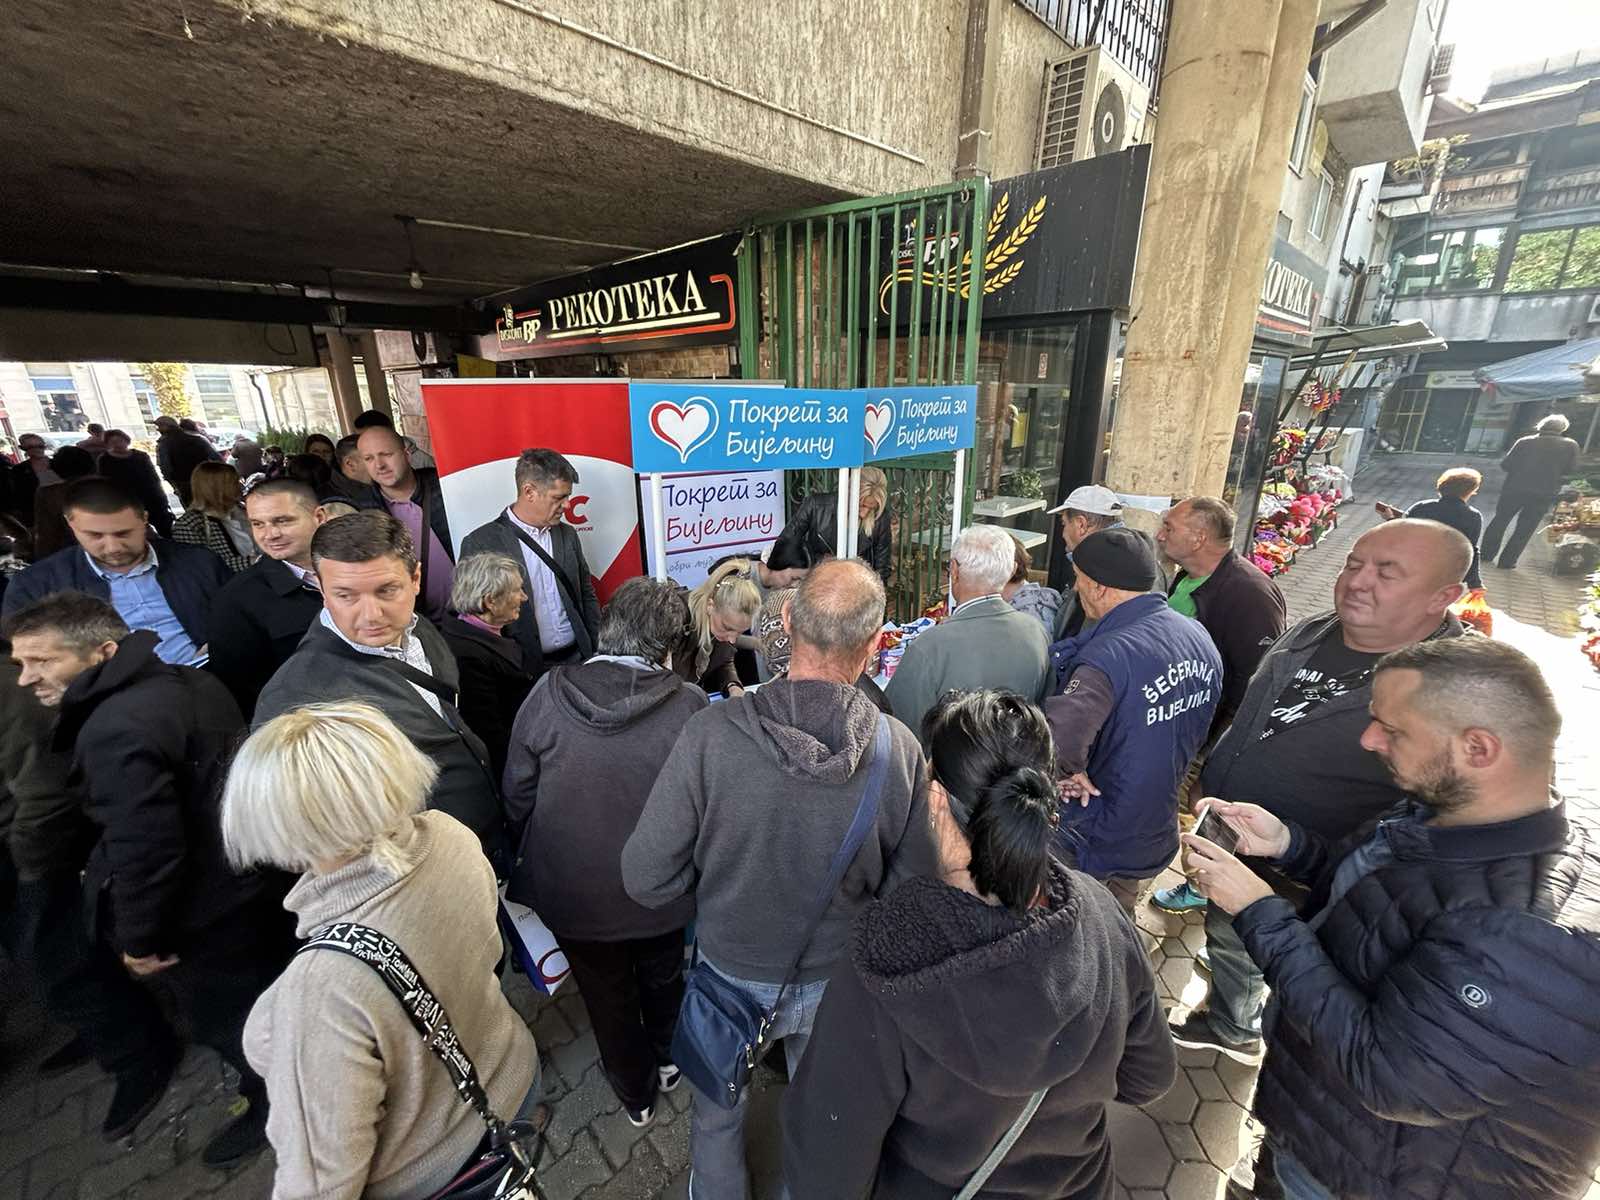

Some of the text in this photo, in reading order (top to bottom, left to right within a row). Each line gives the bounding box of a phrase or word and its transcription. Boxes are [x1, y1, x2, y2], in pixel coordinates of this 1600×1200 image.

[547, 269, 707, 331] PEKOTEKA
[1262, 258, 1313, 317] OTEKA
[827, 409, 849, 424] за
[954, 399, 967, 414] за
[727, 430, 834, 464] Бијељину
[897, 423, 959, 450] Бијељину
[755, 481, 778, 498] за
[667, 512, 773, 544] Бијељину
[1147, 689, 1211, 726] BIJELJINA
